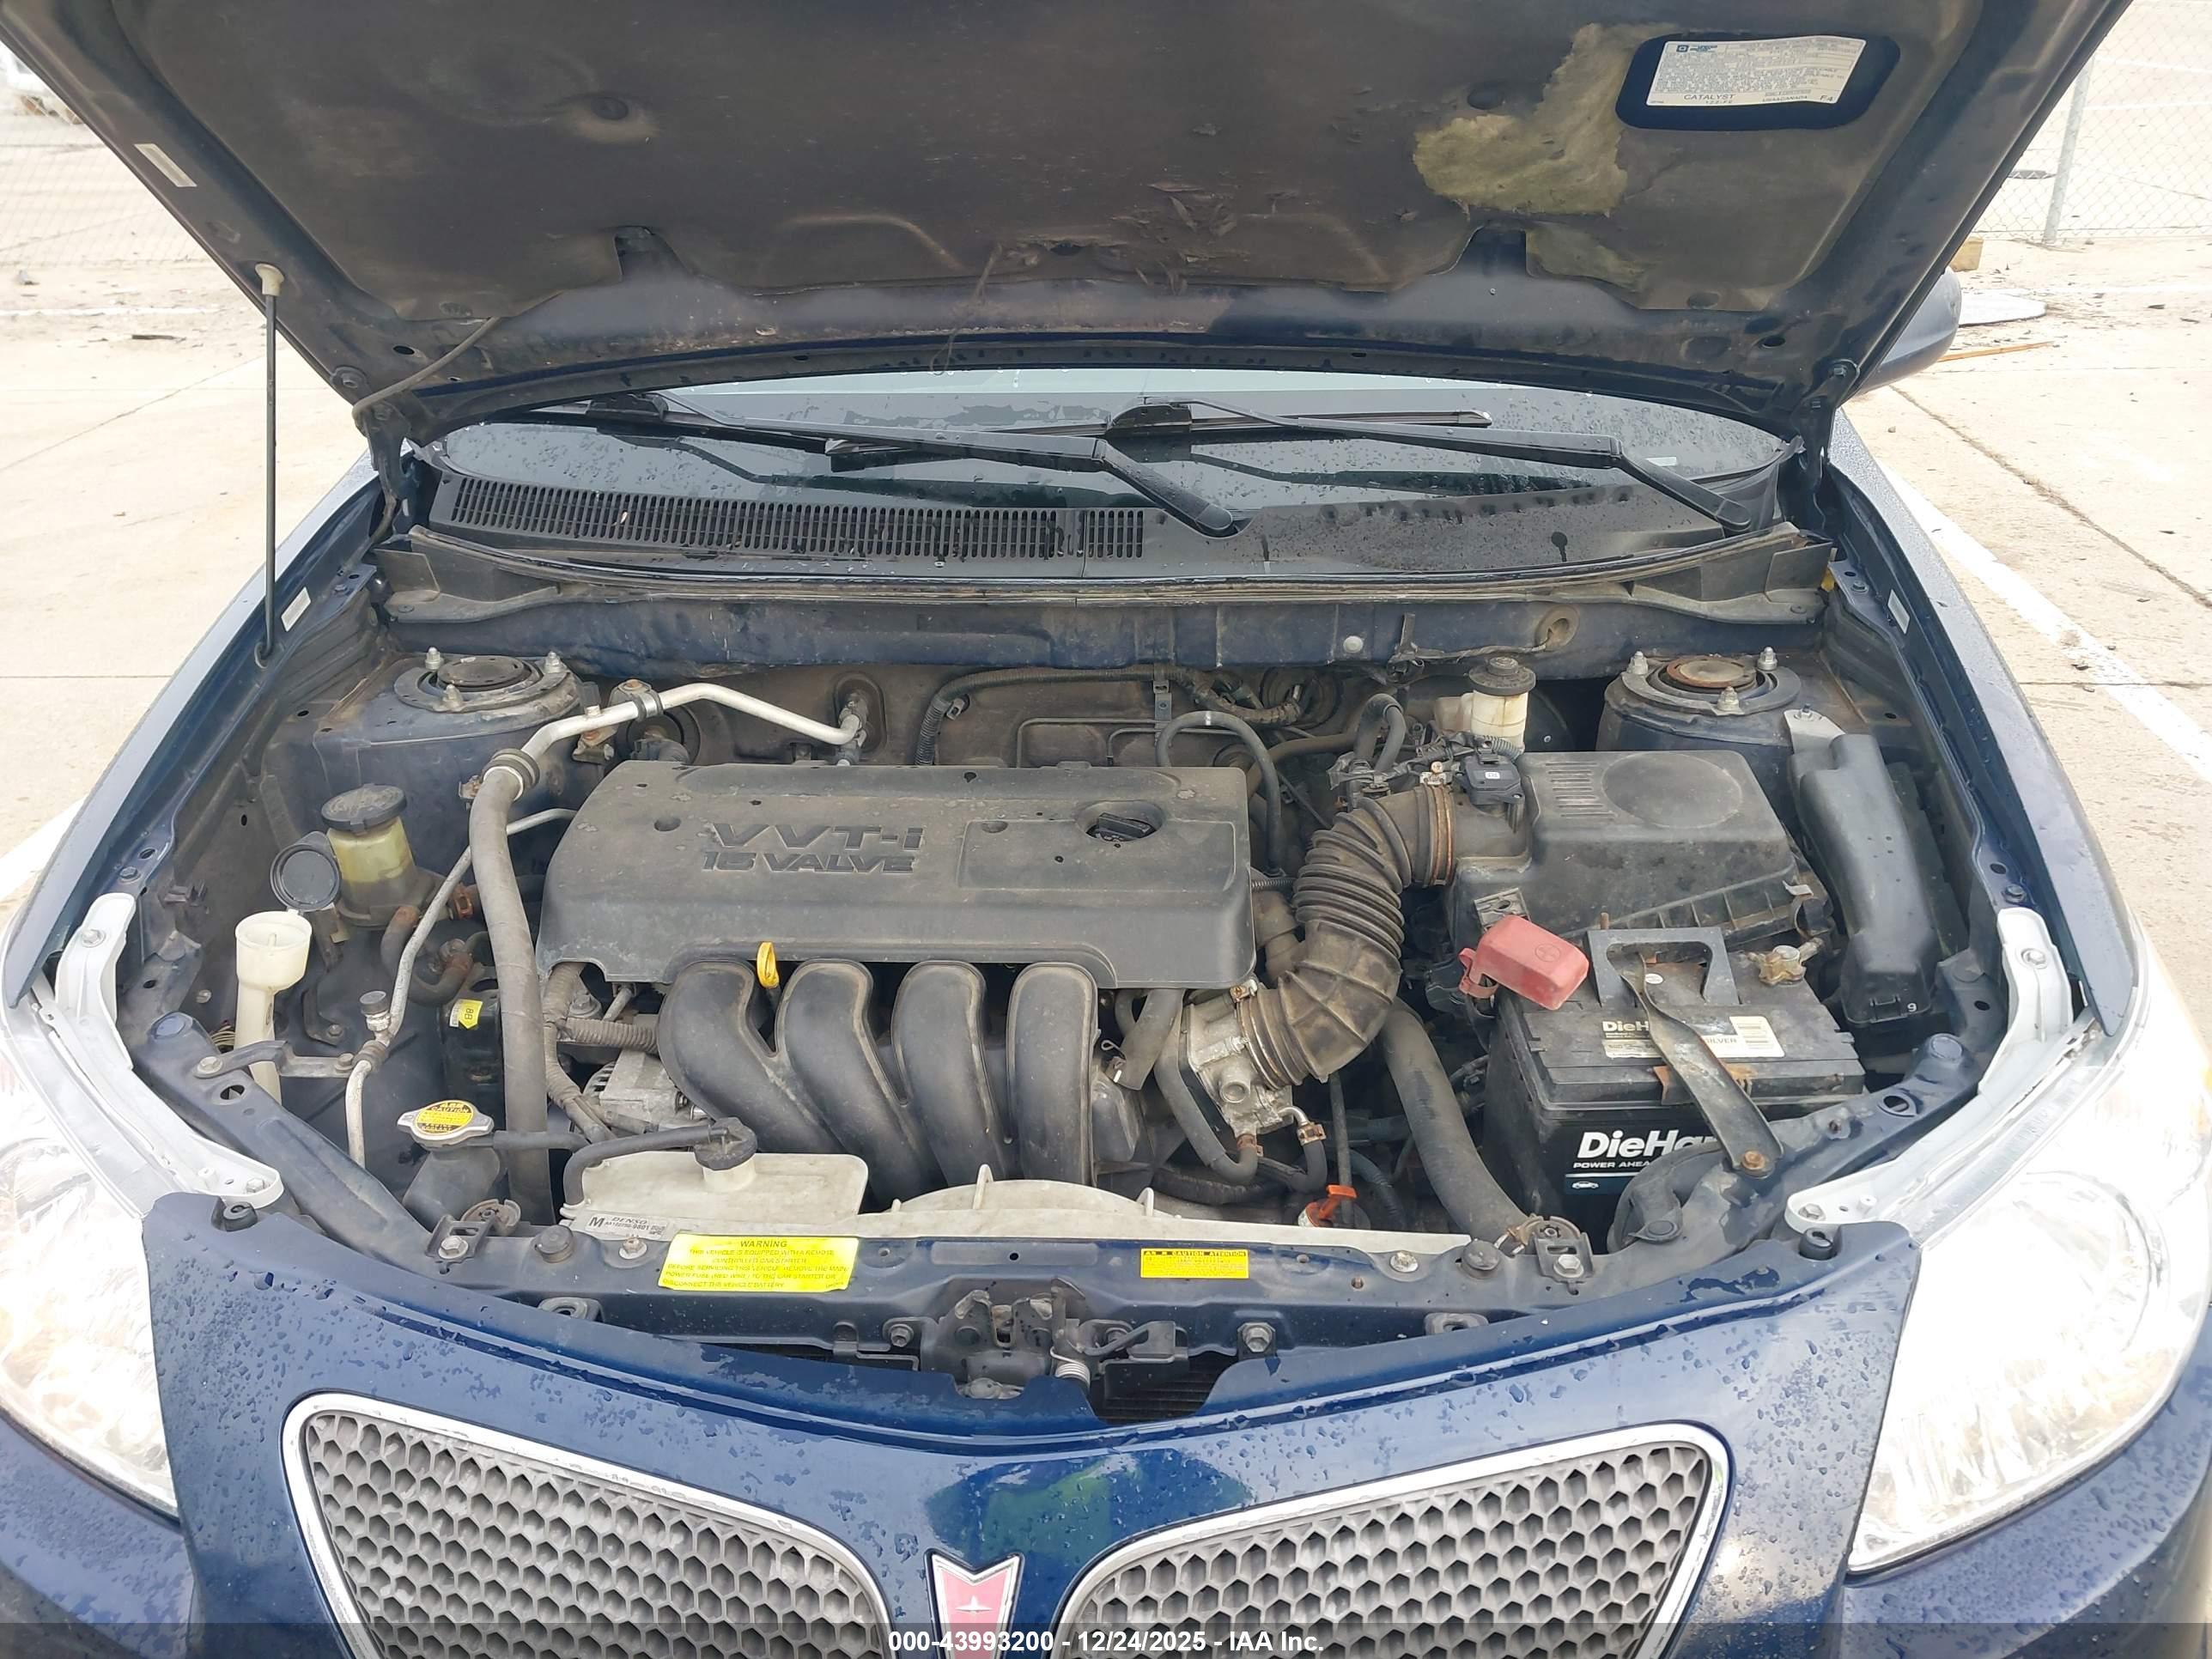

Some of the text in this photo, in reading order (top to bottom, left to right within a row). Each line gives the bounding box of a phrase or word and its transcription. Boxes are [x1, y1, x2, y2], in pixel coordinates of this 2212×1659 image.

[711, 823, 925, 850] VVT-i
[701, 851, 917, 874] 16 VALVE
[1906, 1002, 1917, 1012] 9
[1602, 1020, 1650, 1032] DieH
[1618, 1160, 1651, 1169] AHEA
[588, 1216, 605, 1228] M
